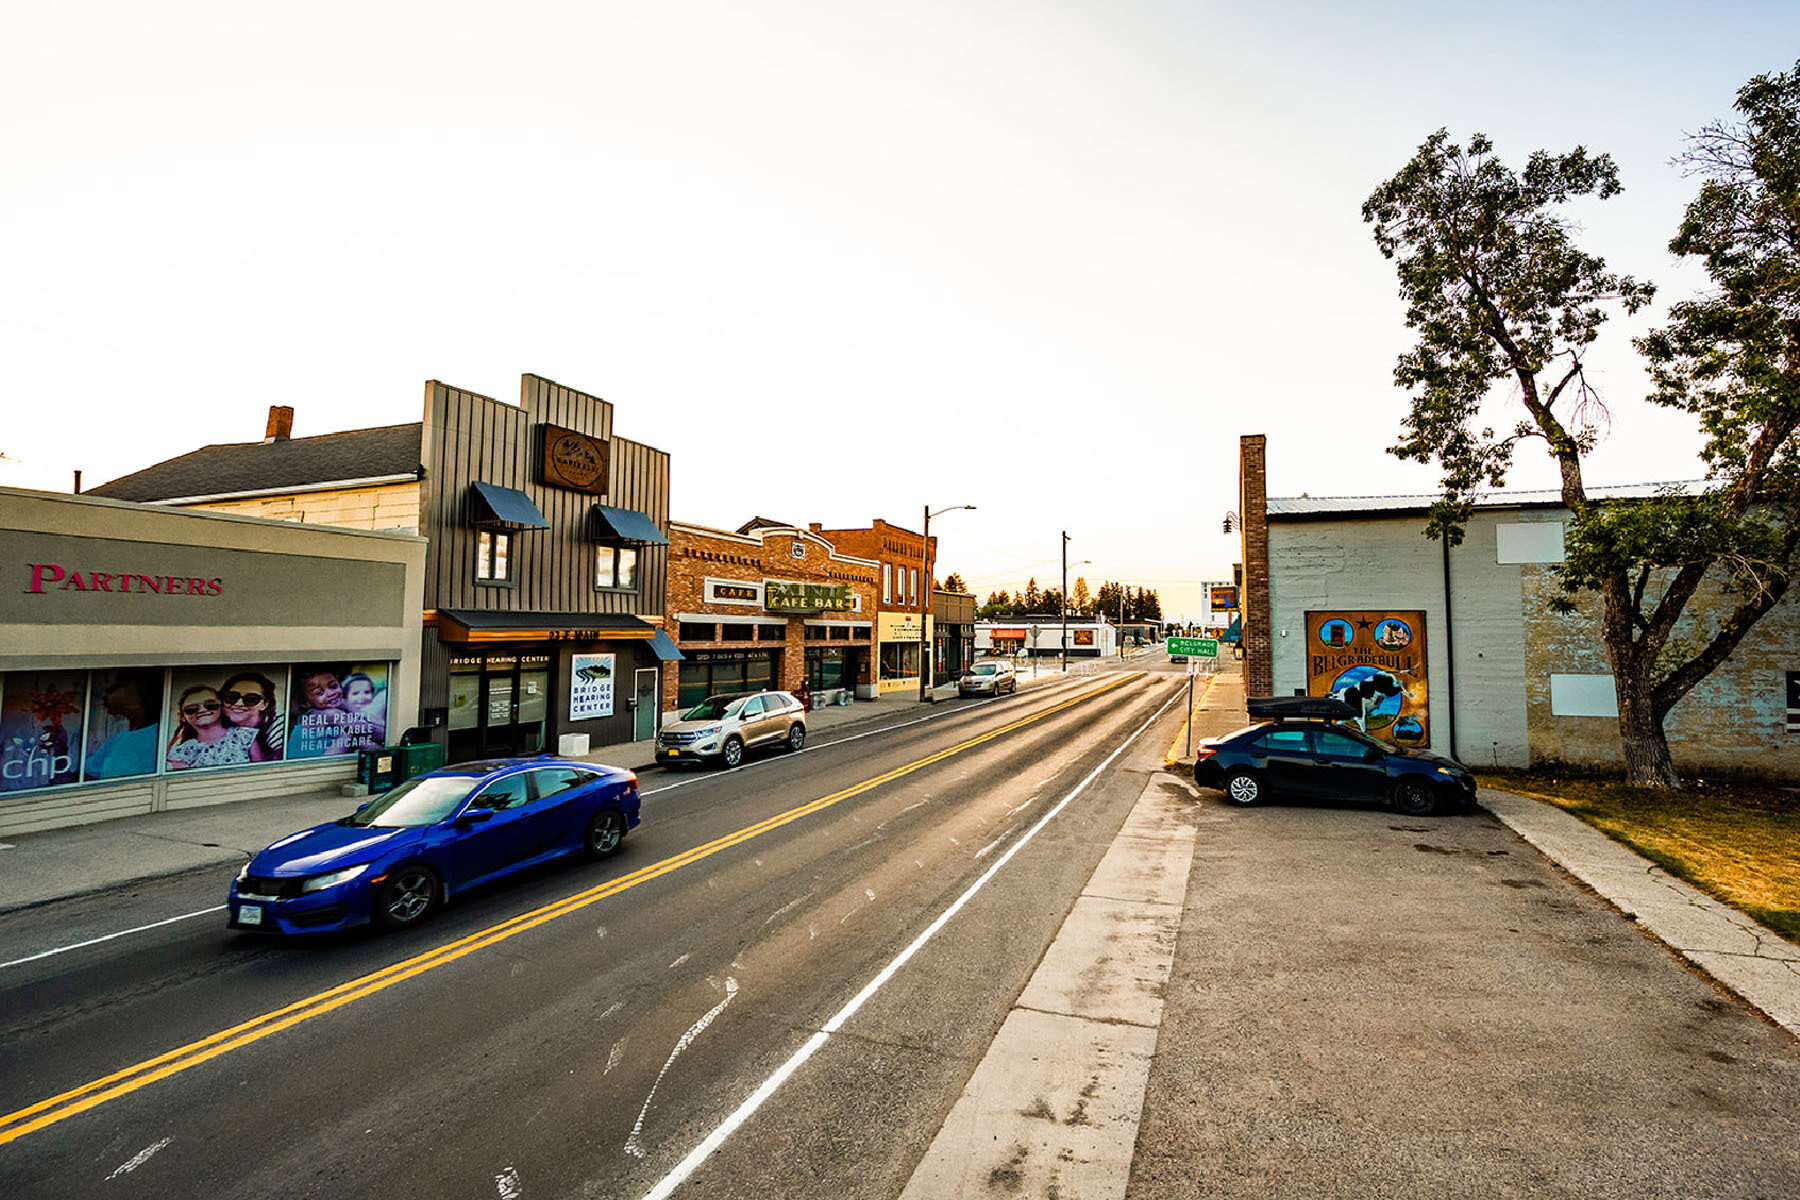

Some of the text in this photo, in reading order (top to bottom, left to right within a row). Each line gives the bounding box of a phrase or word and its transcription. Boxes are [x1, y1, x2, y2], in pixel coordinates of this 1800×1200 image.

[24, 563, 223, 597] PARTNERS
[720, 587, 755, 599] CAFE
[772, 597, 844, 609] CAFE BAR
[1180, 640, 1216, 648] BELGRADE
[1198, 648, 1216, 656] HALL
[1353, 647, 1371, 655] THE
[486, 656, 517, 664] HEARING
[573, 684, 611, 694] BRIDGE
[573, 693, 611, 704] HEARING
[573, 702, 611, 713] CENTER
[302, 714, 329, 726] REAL
[301, 725, 373, 740] REMARKABLE
